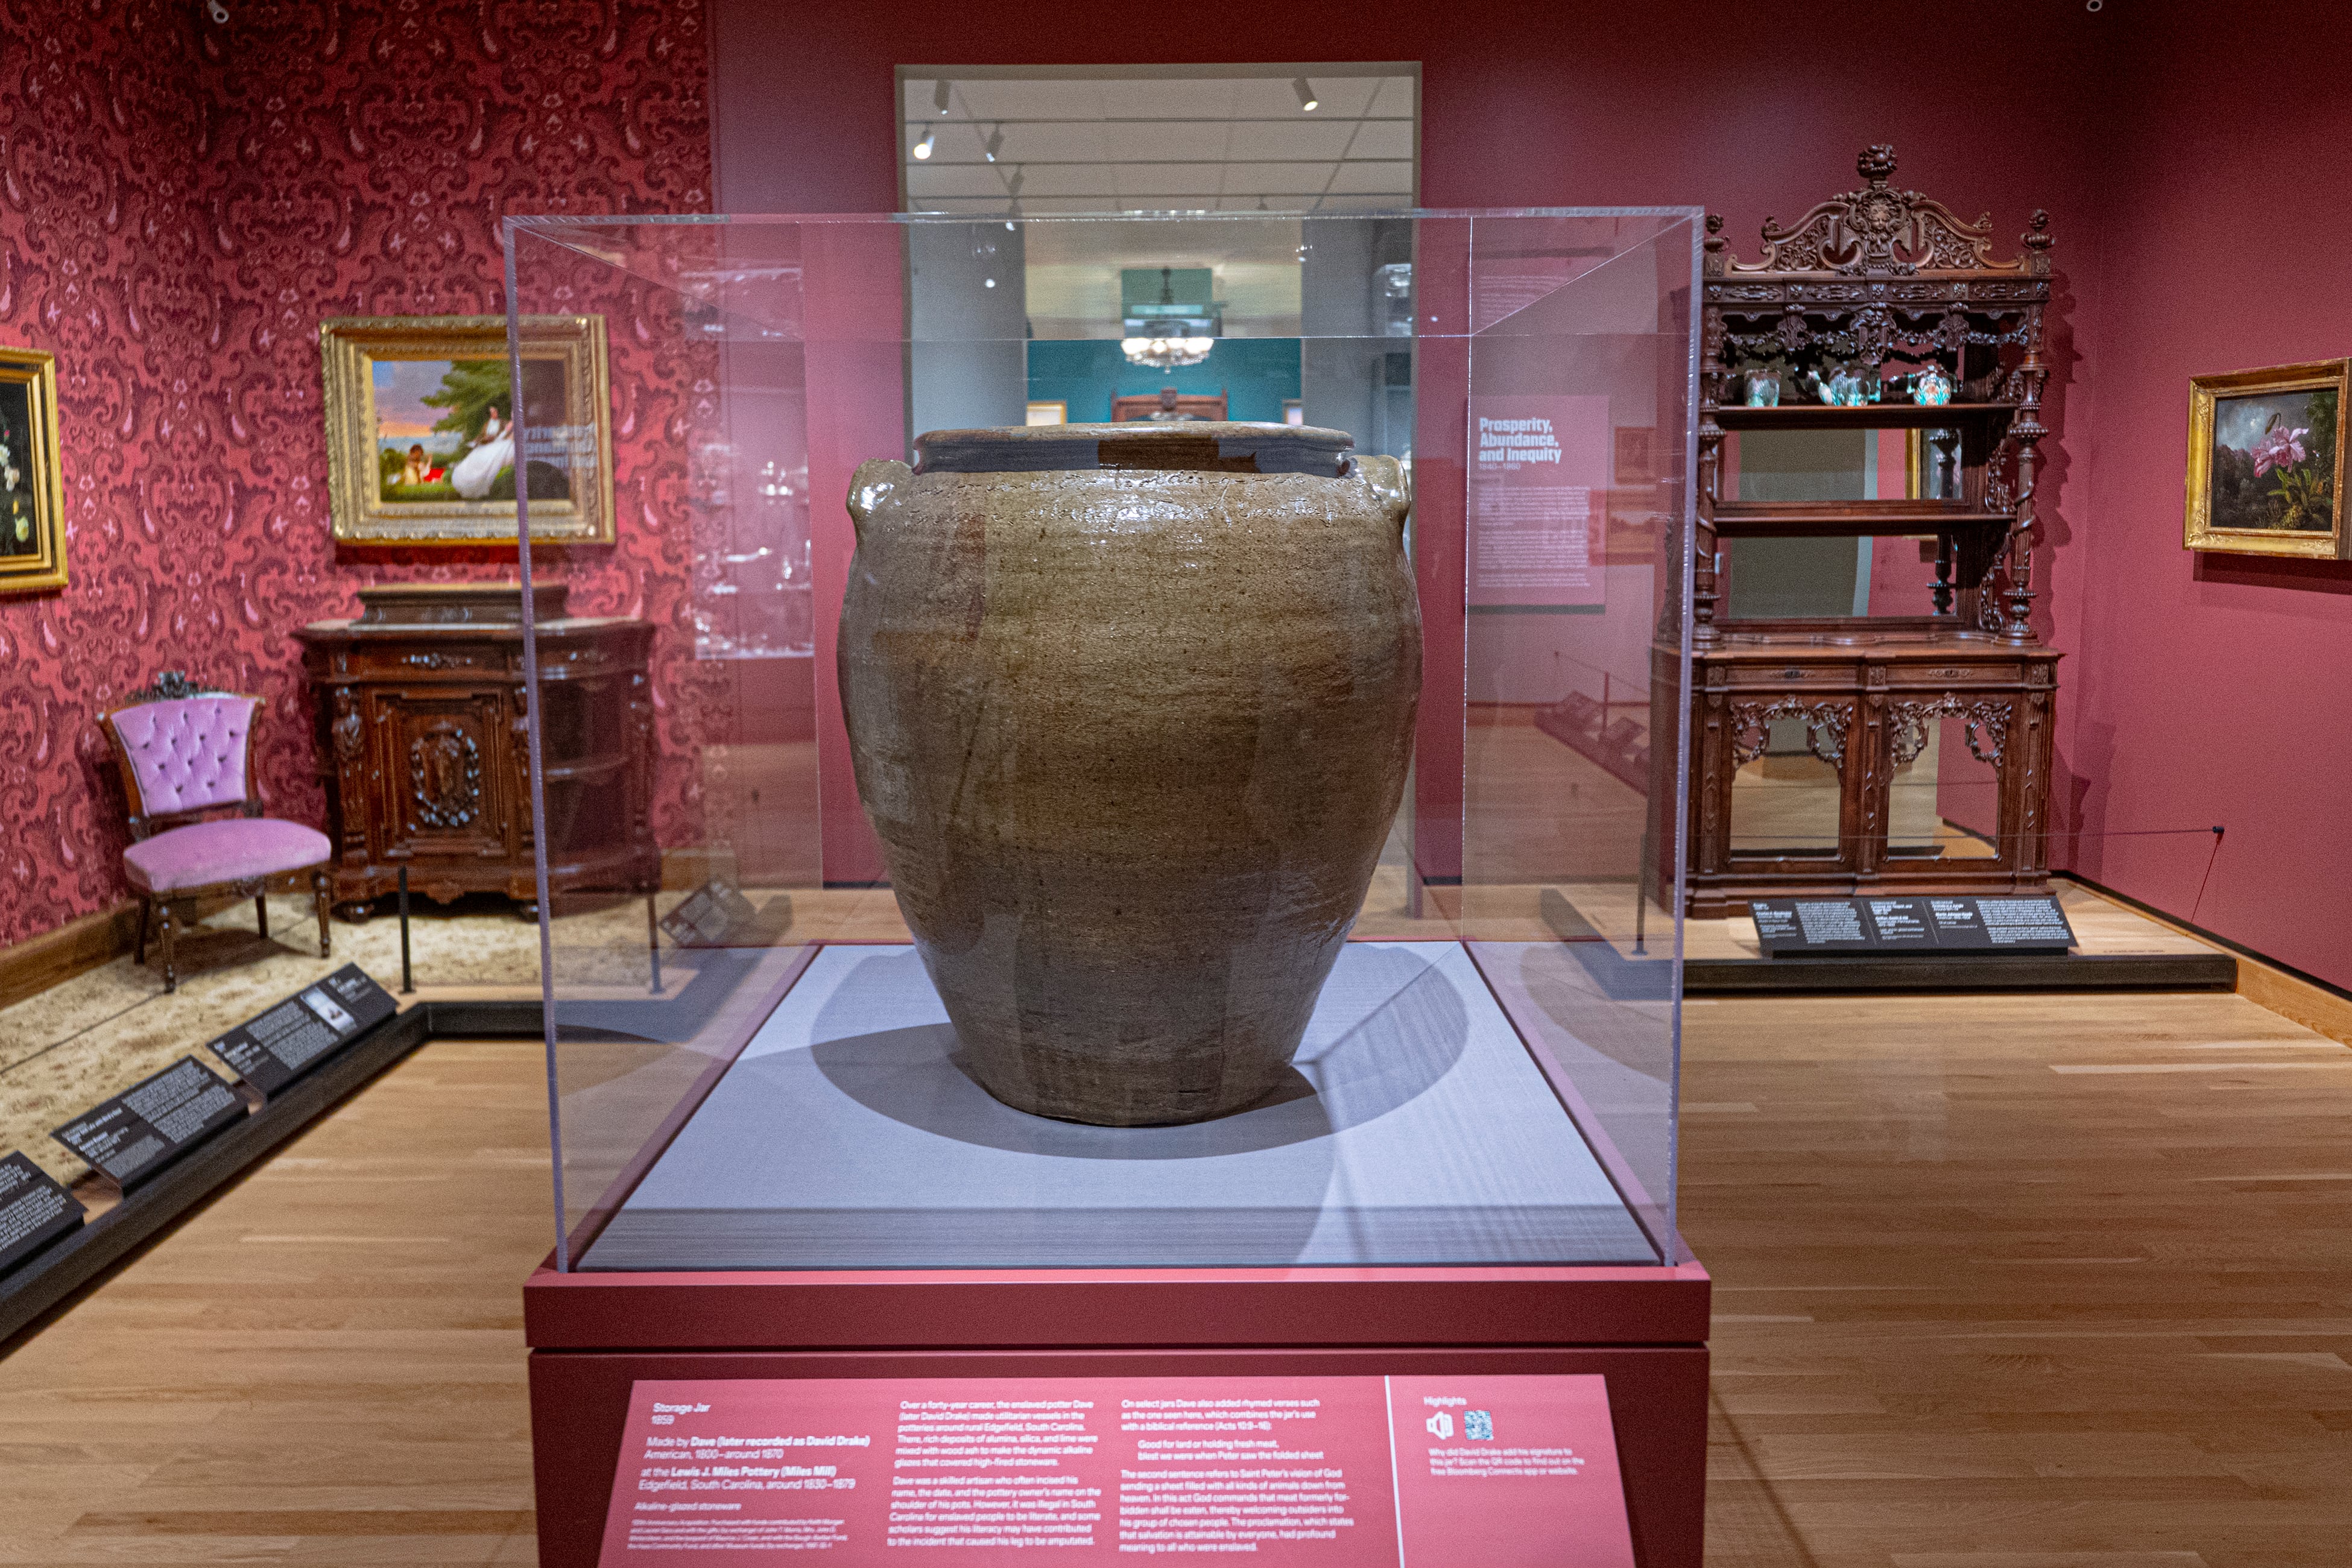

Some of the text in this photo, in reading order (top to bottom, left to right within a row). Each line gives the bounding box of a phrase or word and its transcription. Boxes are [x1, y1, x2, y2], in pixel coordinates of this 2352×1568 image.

[1479, 417, 1553, 434] Prosperity,
[1480, 432, 1560, 447] Abundance,
[1479, 447, 1561, 464] and Inequity
[654, 1403, 710, 1414] Storage Jar
[646, 1437, 675, 1446] Made
[676, 1438, 690, 1447] by
[691, 1437, 716, 1446] Dave
[716, 1437, 745, 1447] (later
[745, 1437, 792, 1446] recorded
[806, 1436, 836, 1446] David
[837, 1435, 870, 1447] Drake)
[653, 1468, 670, 1476] the
[671, 1467, 700, 1476] Lewis
[701, 1467, 711, 1476] J.
[712, 1467, 739, 1476] Miles
[741, 1466, 780, 1478] Pottery
[780, 1466, 812, 1477] (Miles
[813, 1466, 836, 1477] Mill)
